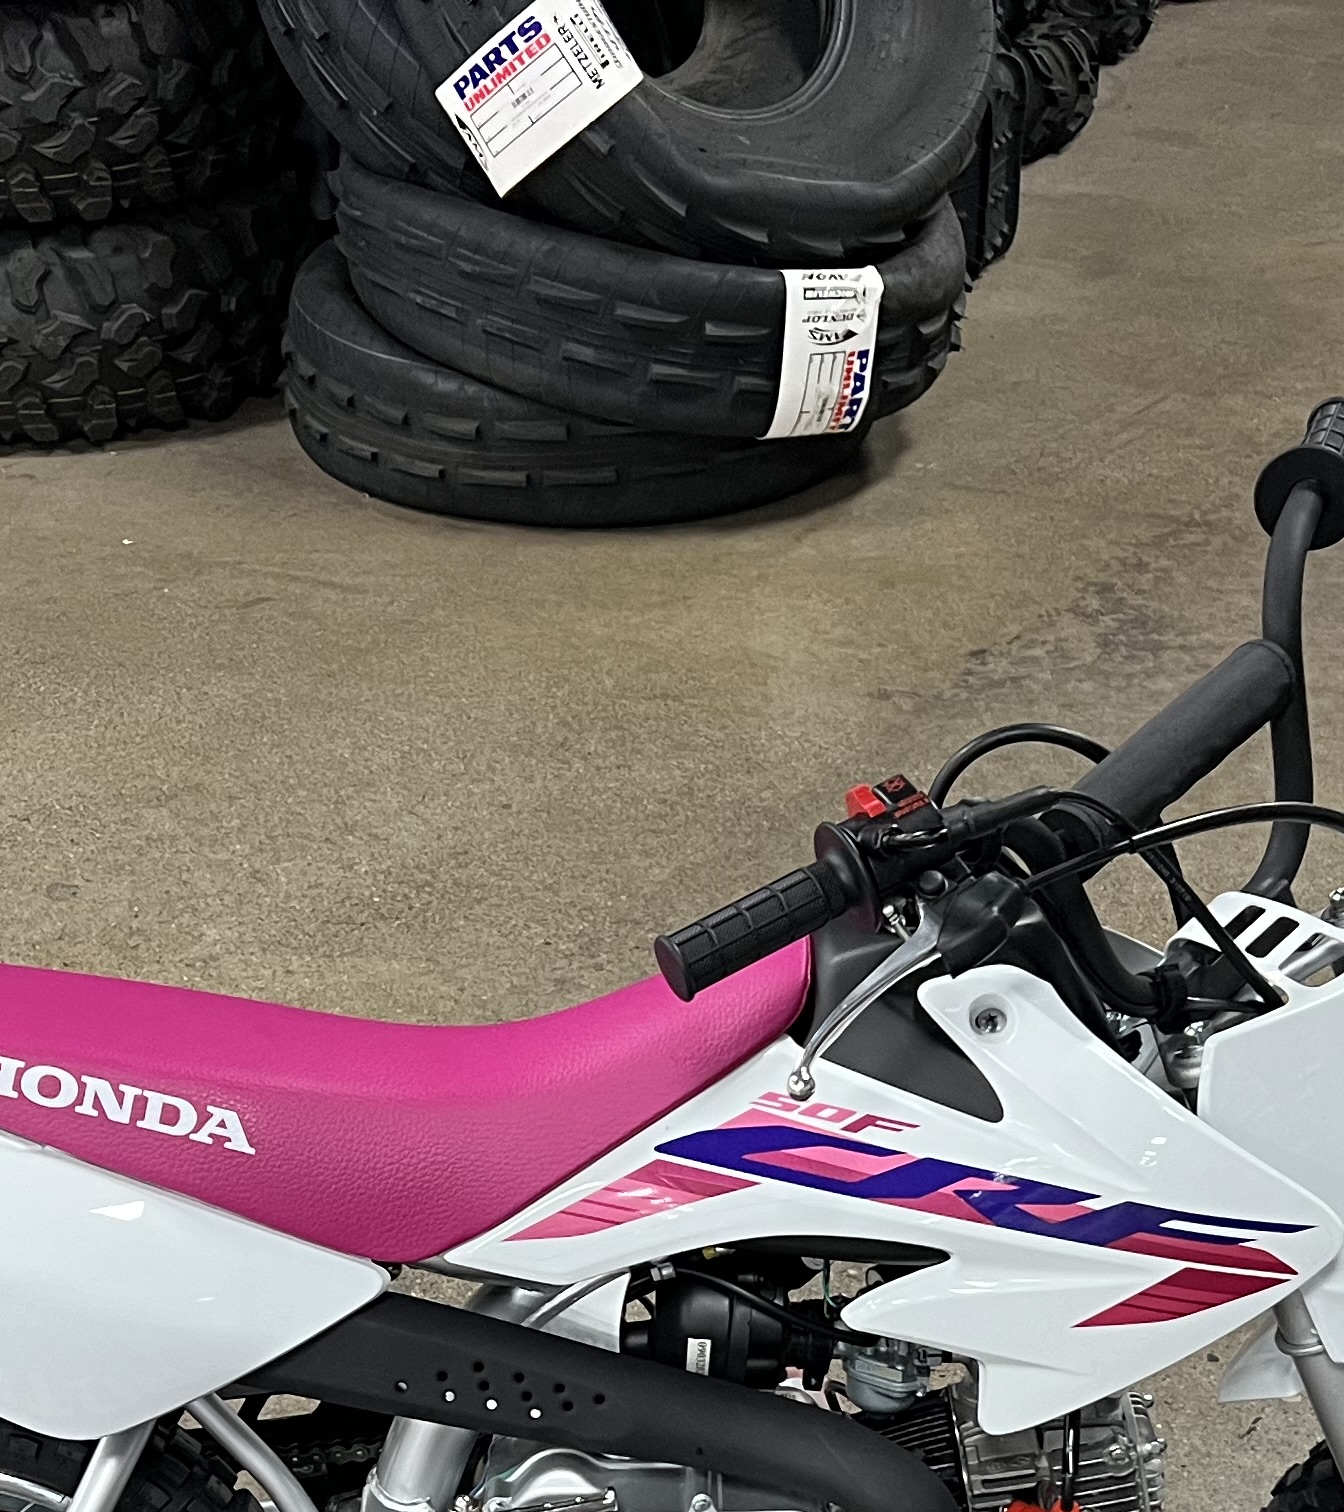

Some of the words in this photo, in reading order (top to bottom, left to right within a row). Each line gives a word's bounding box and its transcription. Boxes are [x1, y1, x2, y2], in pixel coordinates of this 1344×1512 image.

[453, 15, 543, 101] PARTS
[463, 33, 552, 113] UNLIMITED
[558, 26, 606, 90] METZELER
[749, 1091, 922, 1134] 50F
[655, 1124, 1320, 1250] CRF
